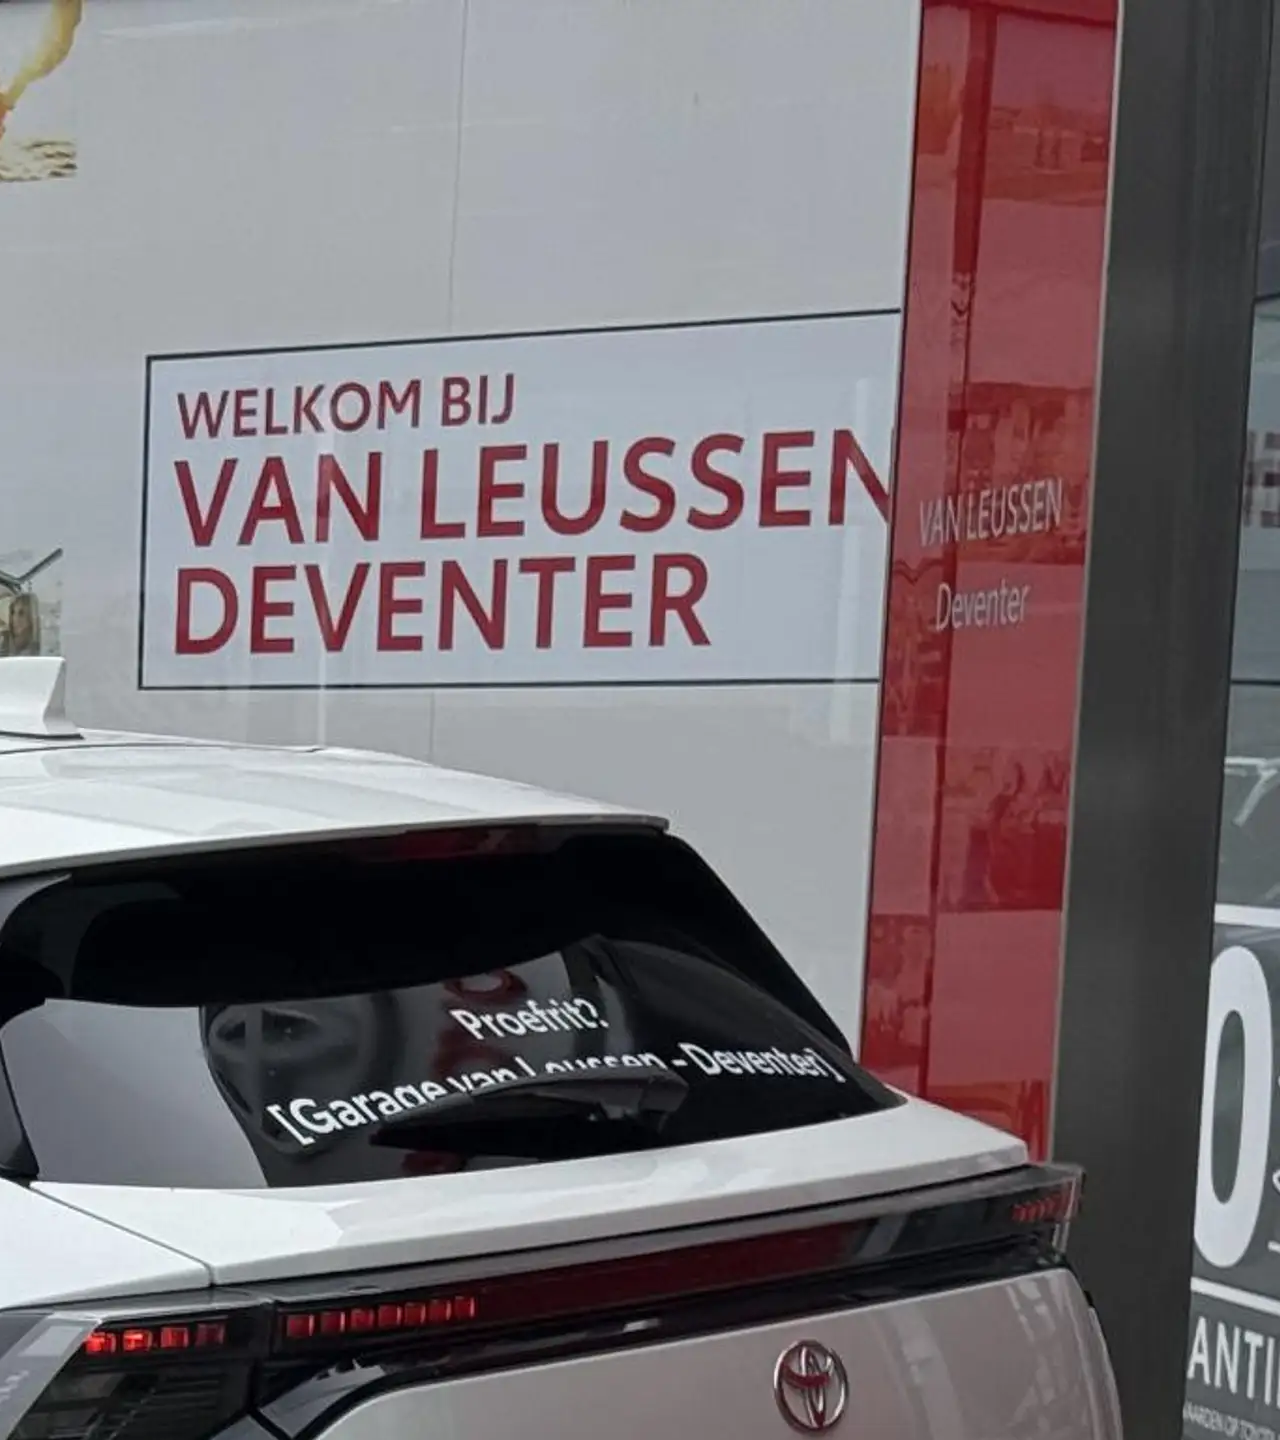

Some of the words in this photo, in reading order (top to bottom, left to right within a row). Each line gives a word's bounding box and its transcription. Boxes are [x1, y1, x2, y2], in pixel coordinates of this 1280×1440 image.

[177, 378, 422, 439] WELKOM
[440, 373, 515, 428] BIJ
[174, 451, 383, 547] VAN
[419, 428, 894, 540] LEUSSEN
[919, 494, 965, 546] VAN
[966, 477, 1062, 541] LEUSSEN
[174, 552, 712, 654] DEVENTER
[935, 578, 1031, 632] Deventer
[450, 996, 610, 1042] Proefrit?
[678, 1042, 846, 1083] Deventer]
[1187, 1316, 1280, 1410] ANTI
